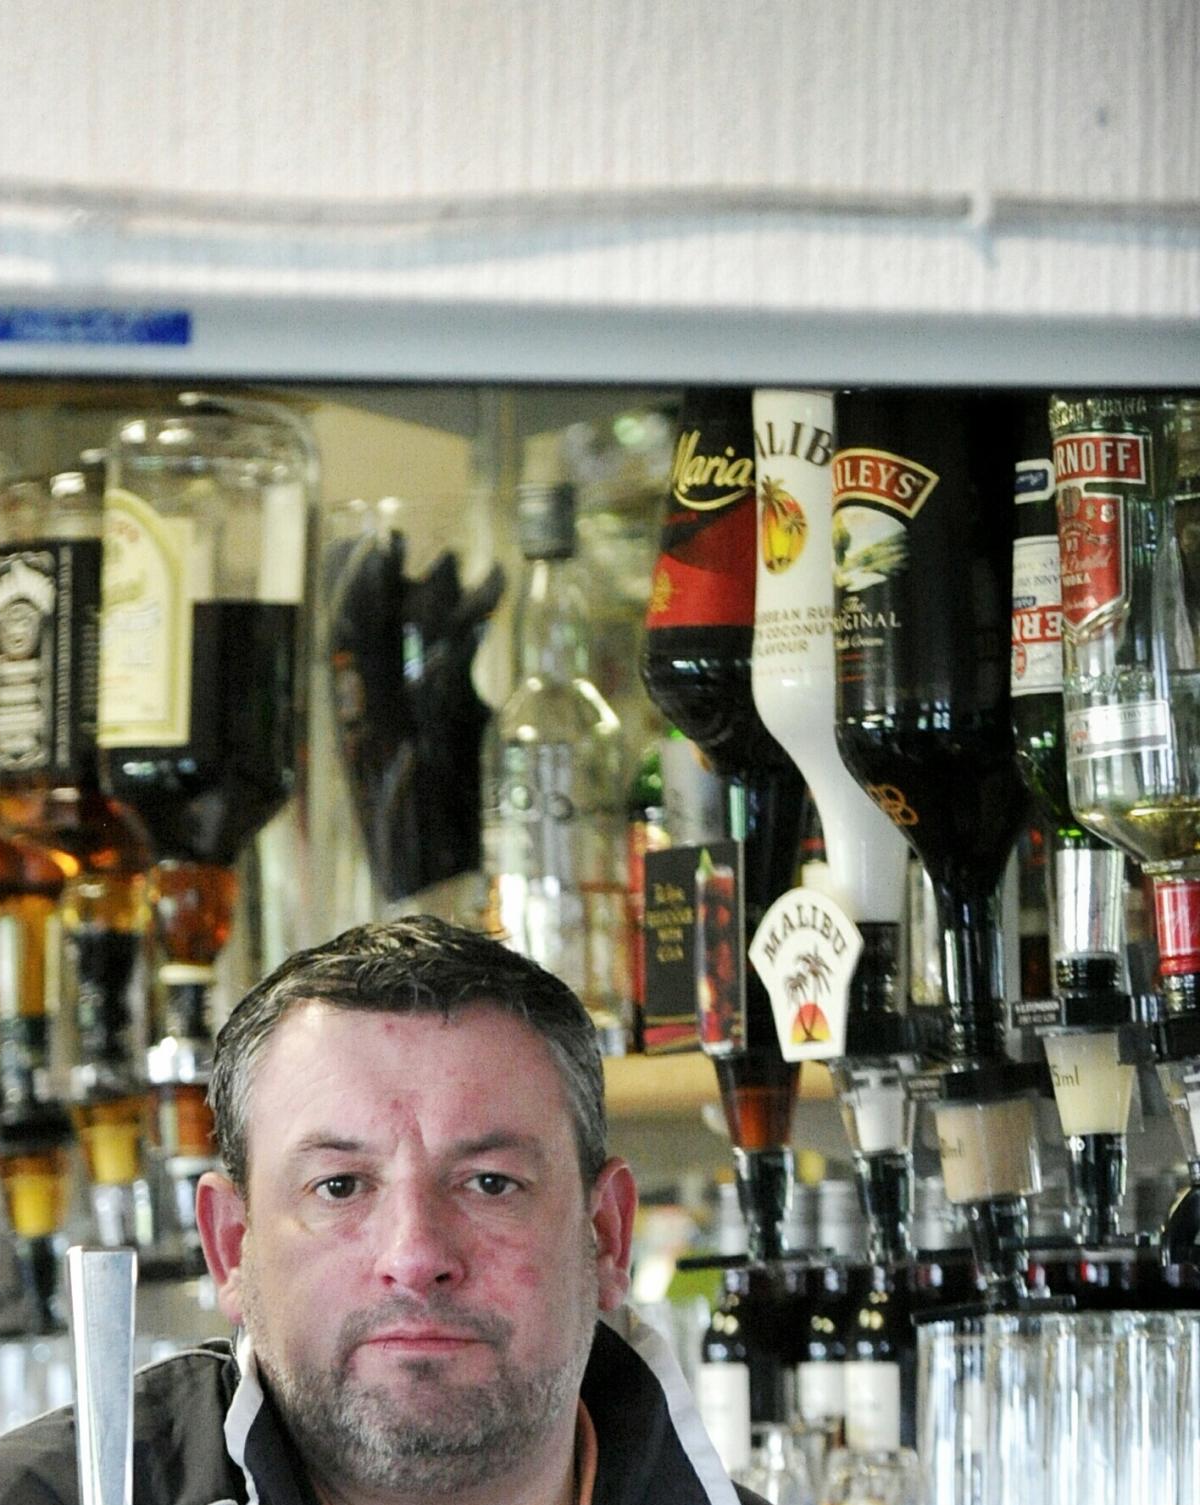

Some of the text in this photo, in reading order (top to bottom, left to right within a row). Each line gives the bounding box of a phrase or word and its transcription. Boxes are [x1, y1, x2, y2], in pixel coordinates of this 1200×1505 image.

[1054, 440, 1132, 477] RNOFF
[832, 459, 919, 499] ILEYS
[764, 904, 847, 962] MALIBU
